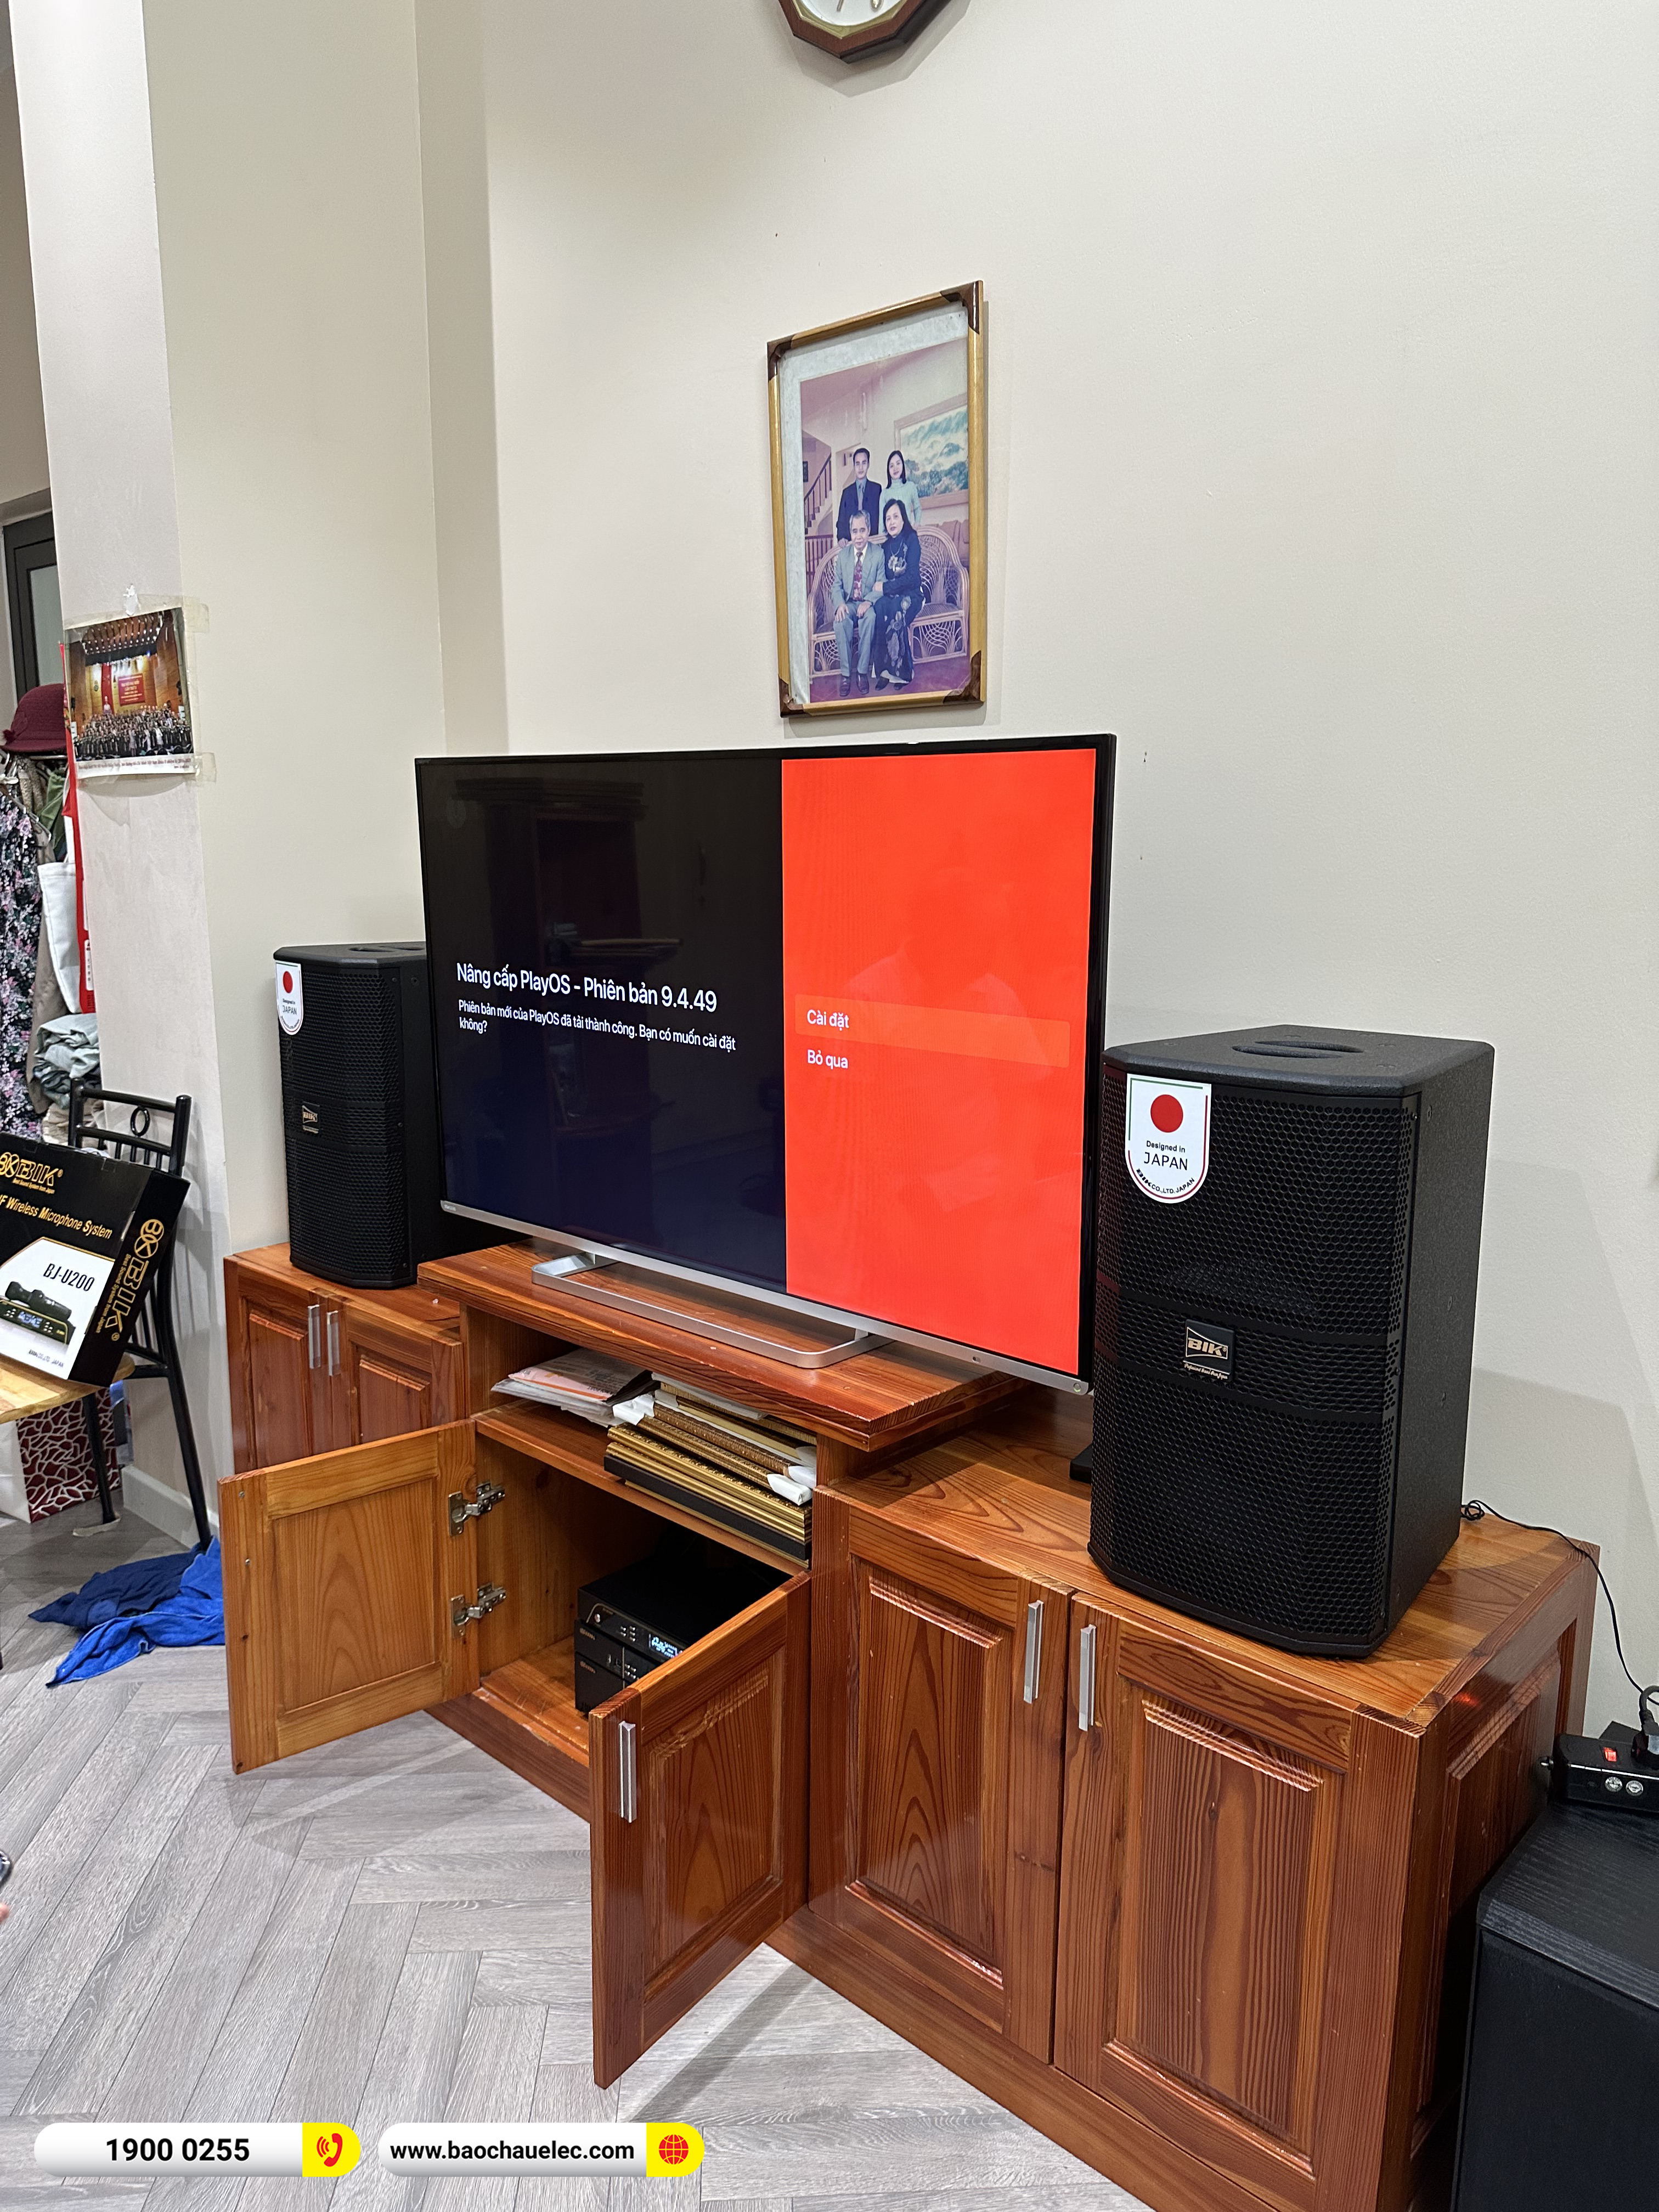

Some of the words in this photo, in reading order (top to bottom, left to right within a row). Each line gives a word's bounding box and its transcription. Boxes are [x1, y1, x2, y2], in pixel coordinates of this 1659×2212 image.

[457, 963, 490, 989] Nâng
[493, 964, 517, 991] cấp
[521, 970, 571, 996] PlayOS
[584, 977, 625, 1001] Phiên
[629, 981, 658, 1005] bản
[661, 985, 718, 1012] 9.4.49
[283, 1005, 297, 1015] JAPAN
[807, 1009, 827, 1025] Cài
[829, 1012, 849, 1031] đặt
[459, 1017, 488, 1034] không?
[459, 999, 480, 1014] Phiên
[481, 1002, 495, 1016] bản
[497, 1005, 512, 1019] mới
[513, 1007, 528, 1021] của
[529, 1009, 560, 1026] PlayOS
[561, 1014, 572, 1027] đã
[573, 1015, 584, 1029] tải
[585, 1017, 611, 1033] thành
[612, 1021, 637, 1039] công.
[639, 1024, 658, 1041] Bạn
[659, 1027, 672, 1041] có
[673, 1028, 701, 1046] muốn
[702, 1032, 717, 1048] cài
[719, 1035, 736, 1053] đặt
[807, 1049, 823, 1065] Bỏ
[825, 1055, 848, 1070] qua
[1146, 1140, 1177, 1152] Designed
[1144, 1152, 1188, 1171] JAPAN
[1176, 1177, 1195, 1193] JAPAN
[6, 1197, 40, 1216] Wireless
[38, 1206, 83, 1231] Microphone
[82, 1220, 112, 1239] System
[43, 1263, 95, 1291] BJ-U200
